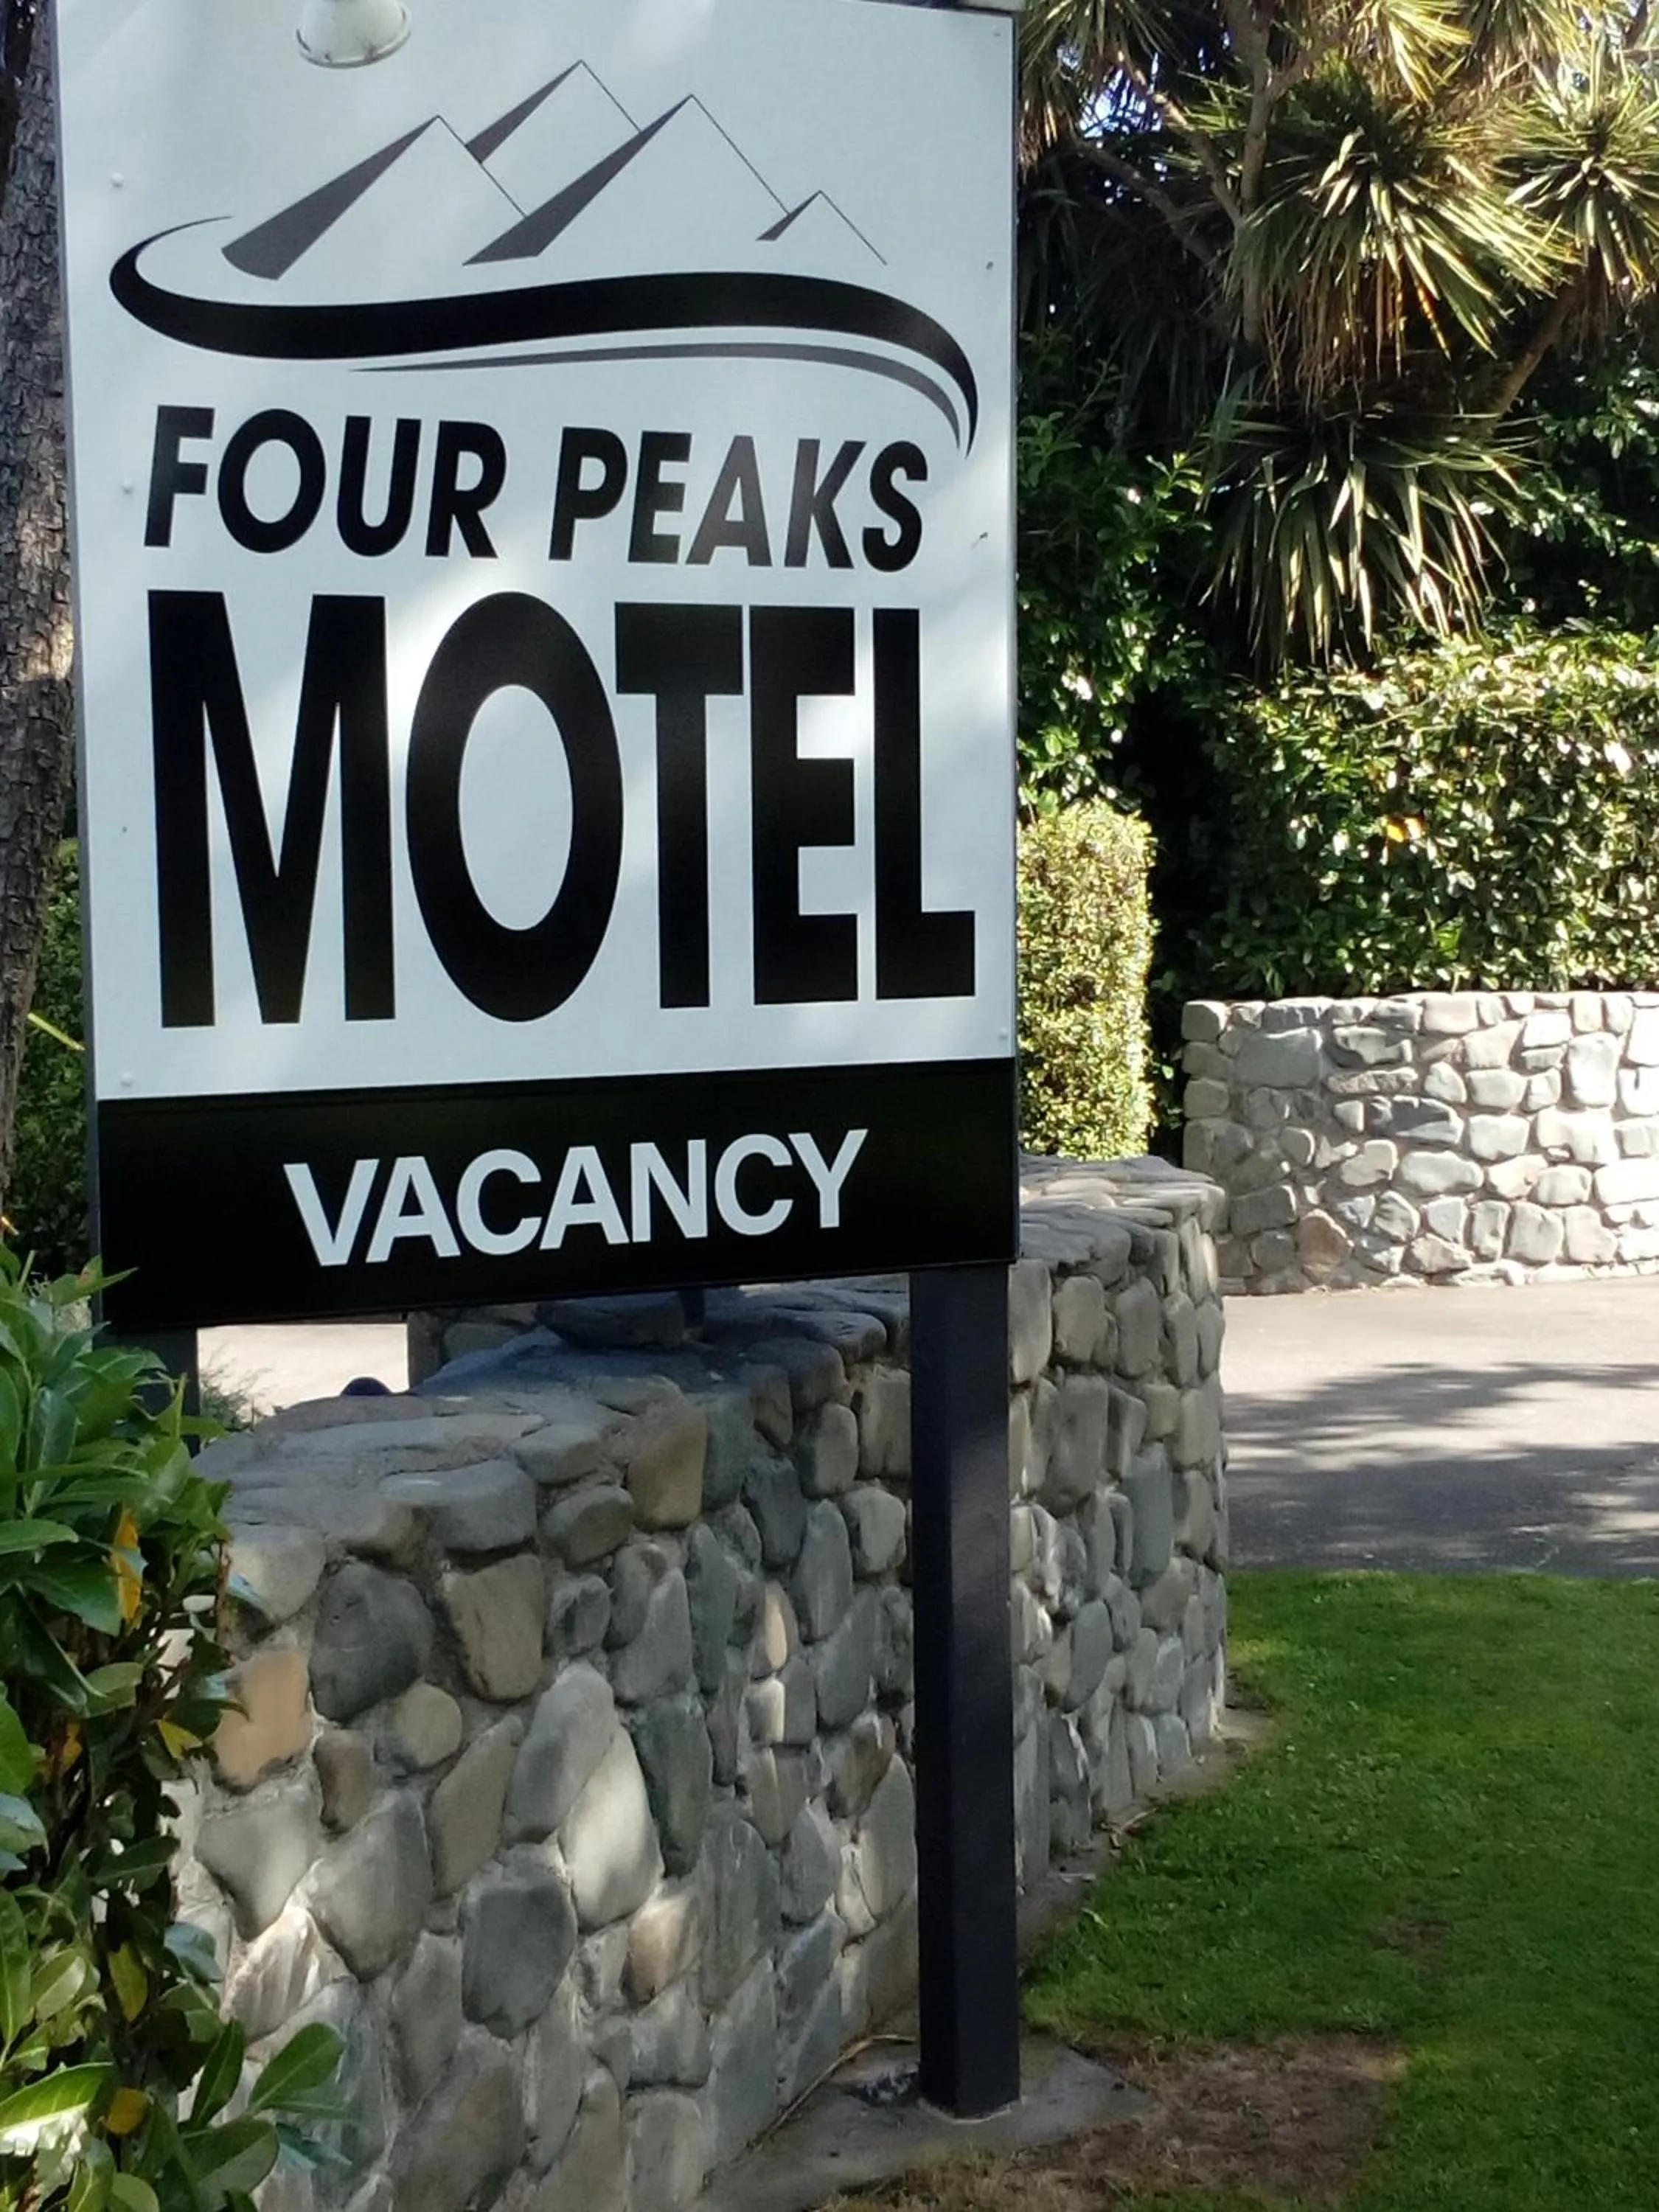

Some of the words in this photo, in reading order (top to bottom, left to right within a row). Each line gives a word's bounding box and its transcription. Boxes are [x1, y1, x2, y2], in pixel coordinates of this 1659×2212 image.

[145, 406, 506, 558] FOUR
[549, 427, 928, 572] PEAKS
[147, 590, 975, 1029] MOTEL
[283, 1129, 868, 1266] VACANCY
